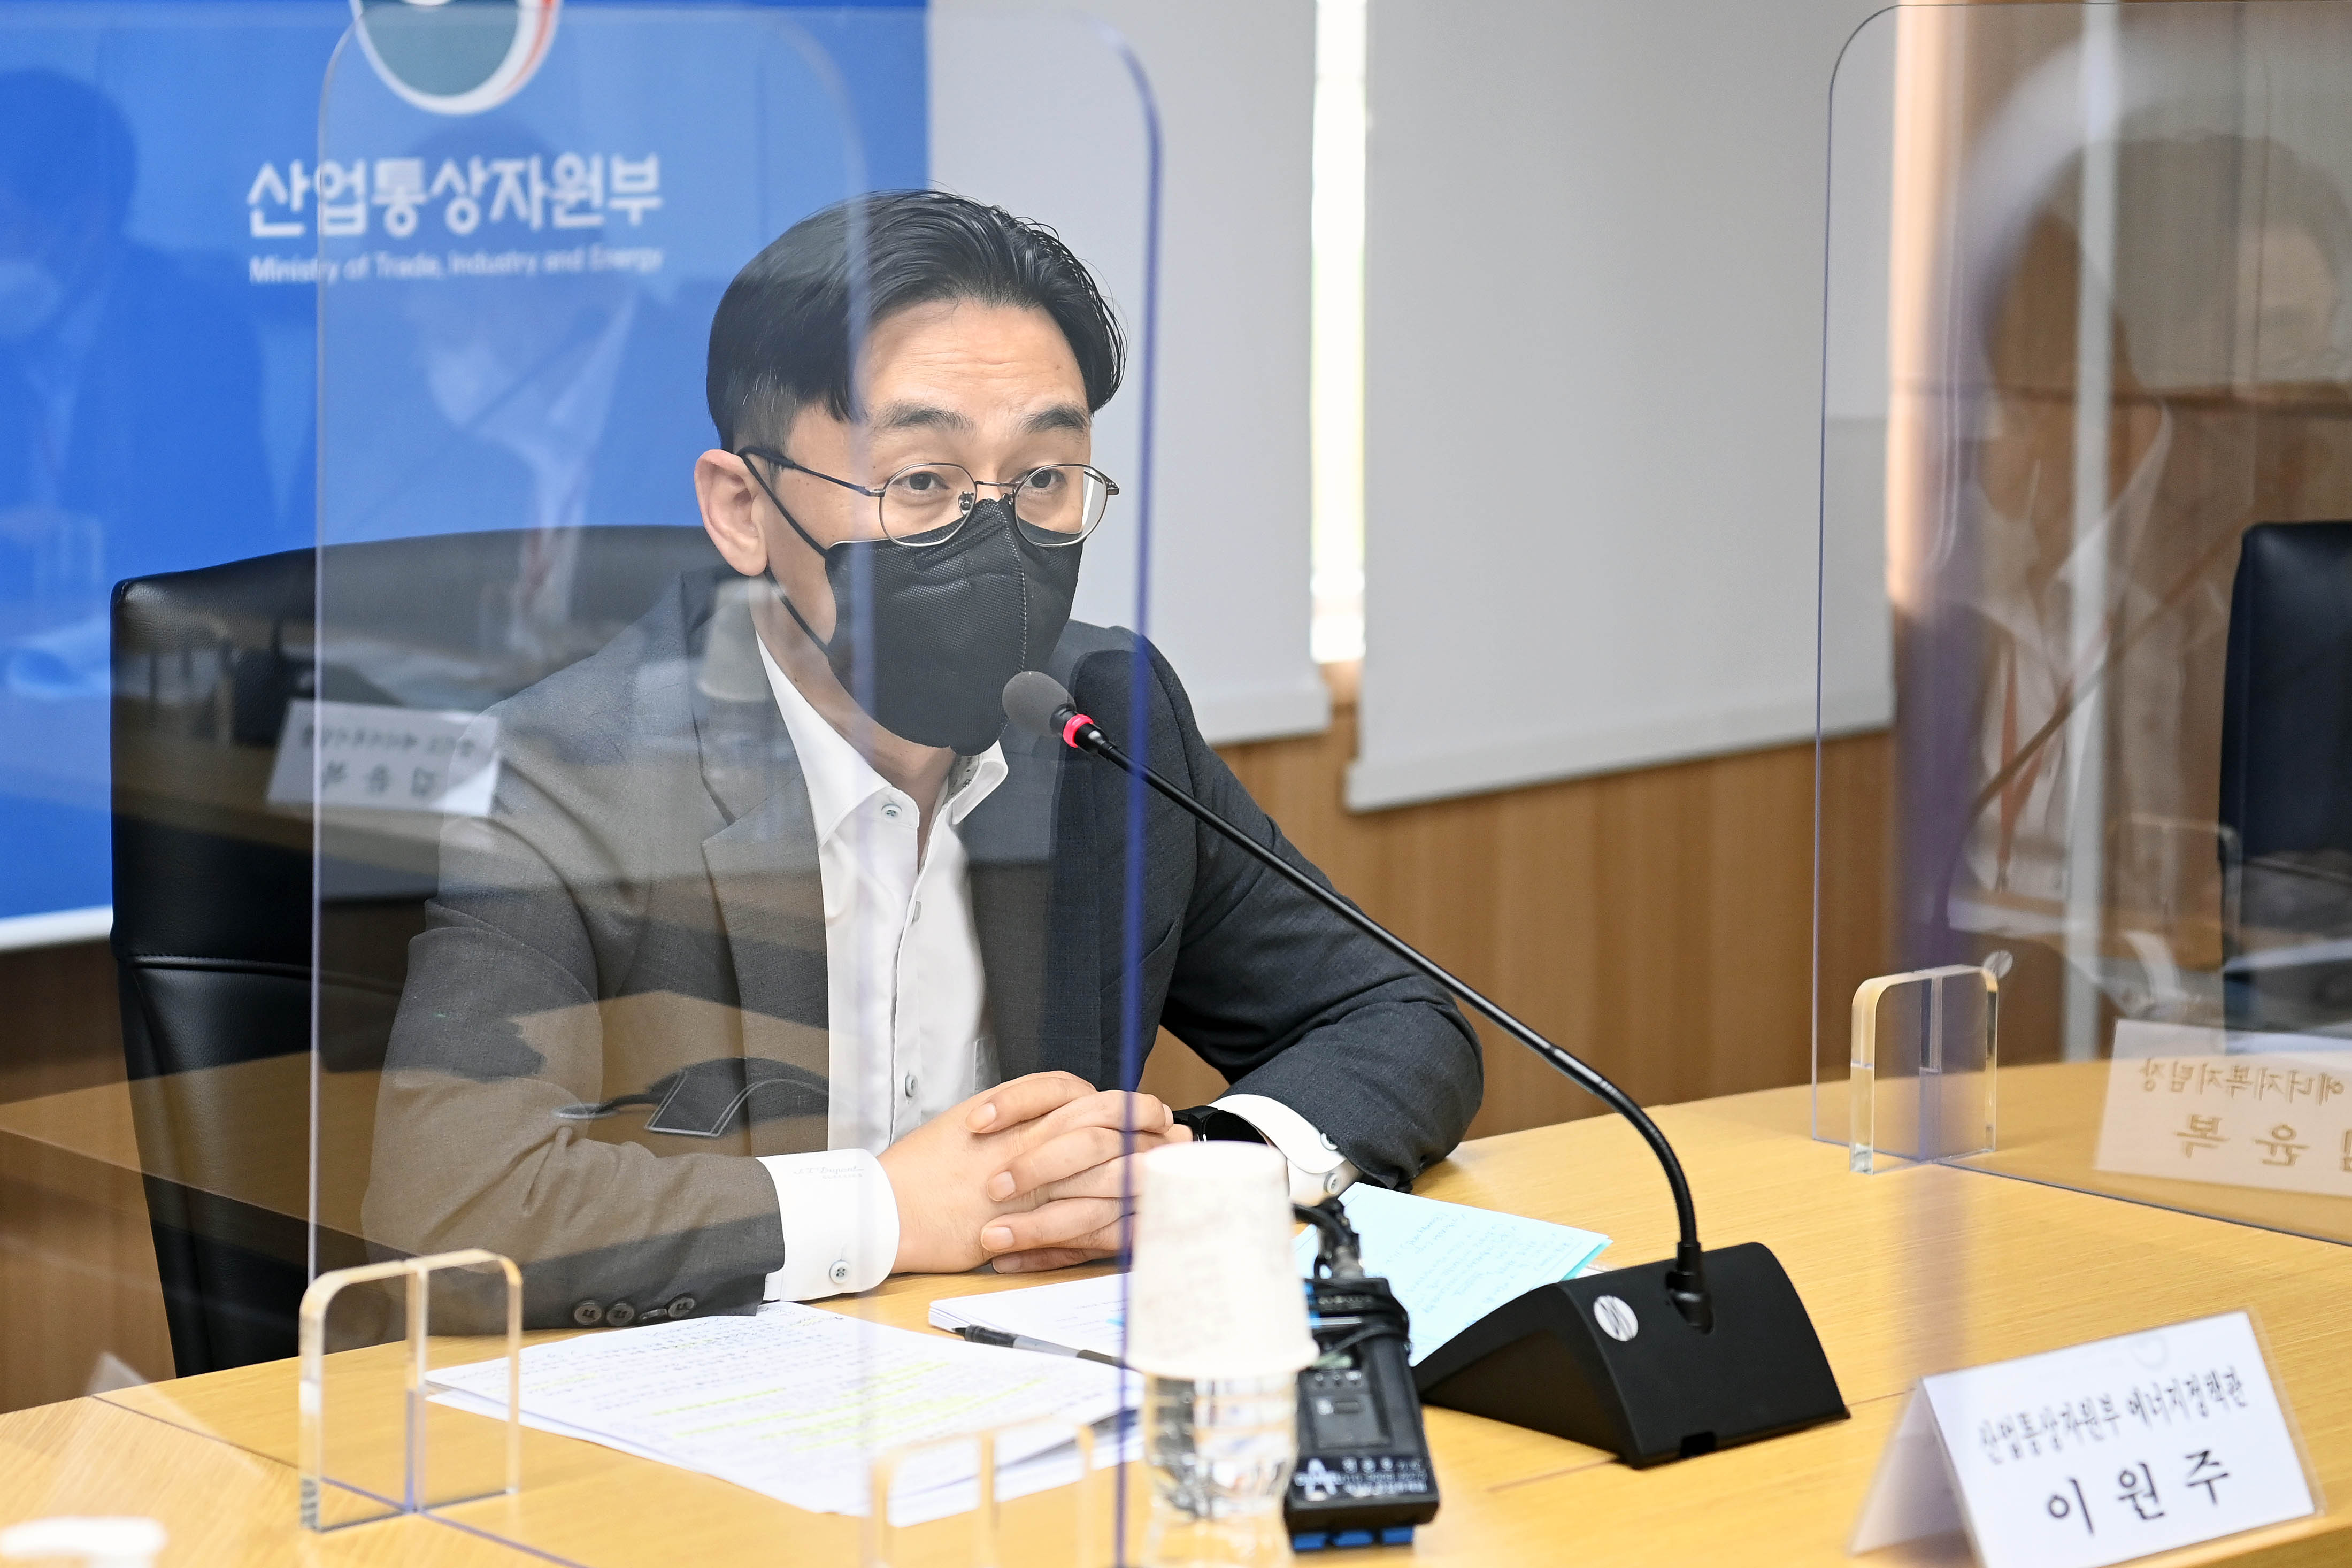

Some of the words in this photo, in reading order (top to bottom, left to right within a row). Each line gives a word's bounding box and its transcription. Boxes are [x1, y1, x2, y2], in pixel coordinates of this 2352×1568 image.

[247, 152, 663, 238] 산업통상자원부
[250, 255, 338, 284] Ministry
[343, 252, 369, 280] of
[448, 250, 537, 278] Industry
[543, 247, 585, 273] and
[590, 243, 663, 274] Energy
[1980, 1394, 2120, 1464] 산업통상자원부
[2127, 1366, 2248, 1429] 에너지정책관
